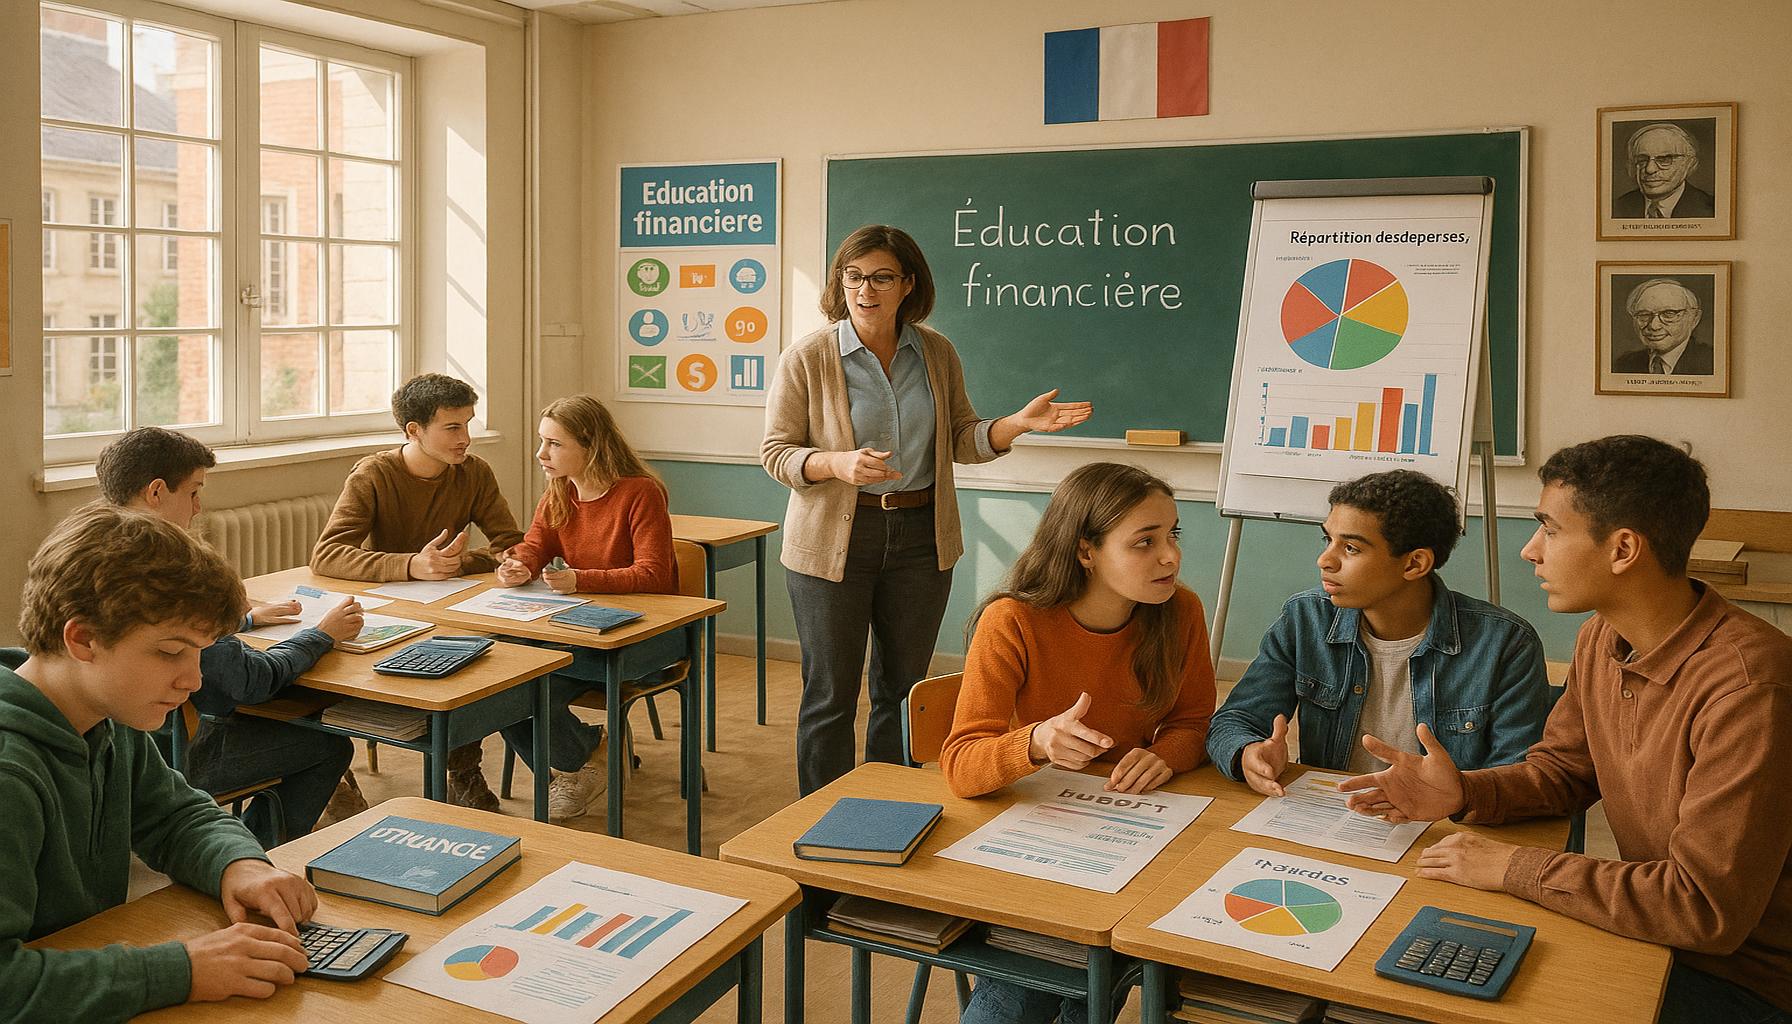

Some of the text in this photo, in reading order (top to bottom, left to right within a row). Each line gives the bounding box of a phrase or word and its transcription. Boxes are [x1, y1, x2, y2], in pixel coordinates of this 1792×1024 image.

[642, 179, 754, 206] Education
[633, 209, 763, 236] financiere
[954, 197, 1177, 248] Éducation
[1290, 230, 1372, 246] Répartition
